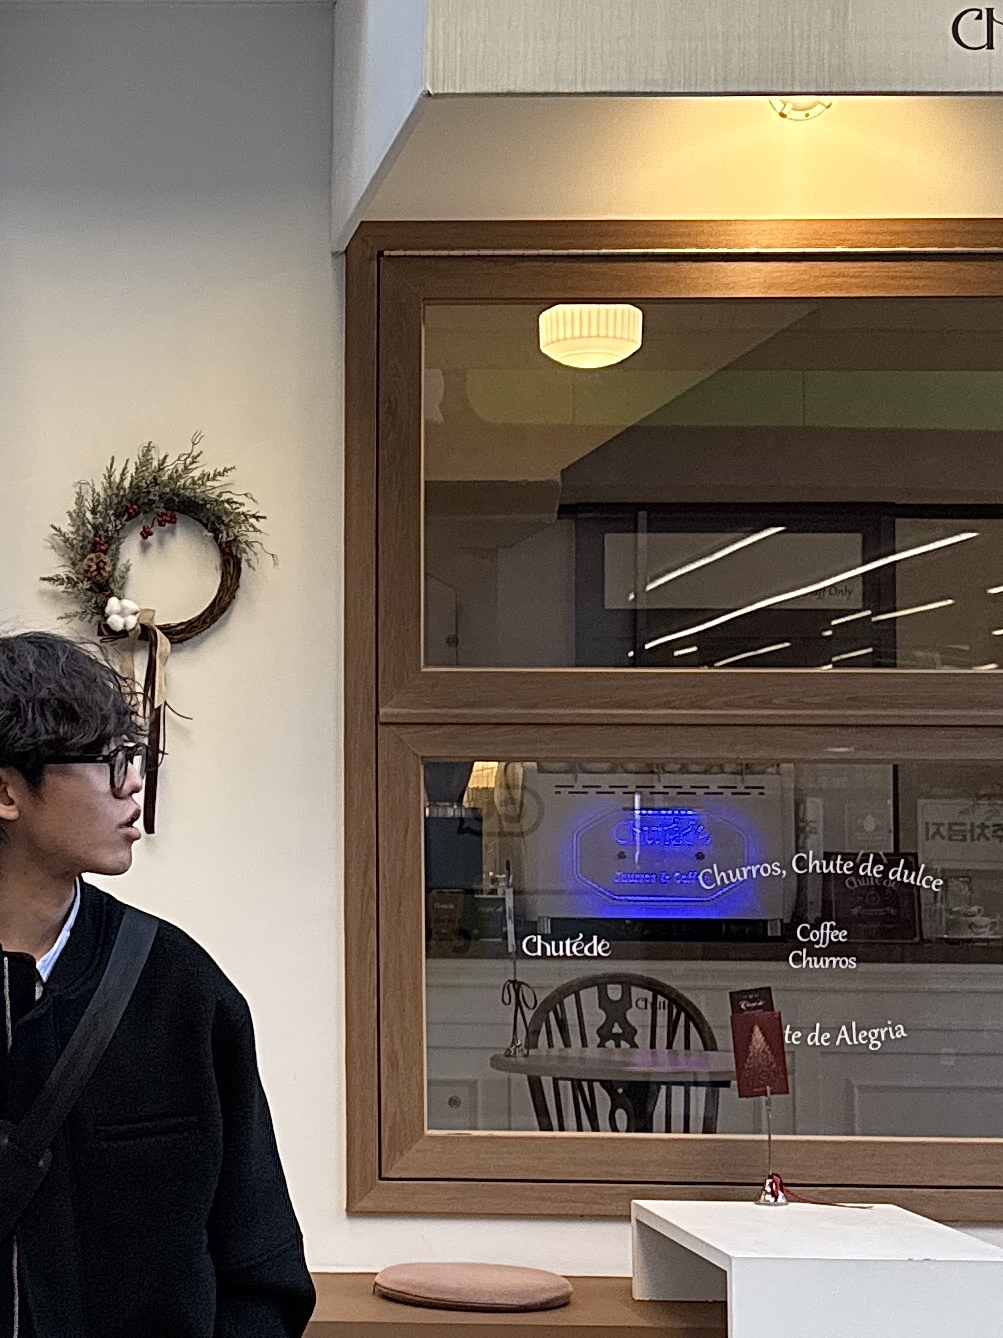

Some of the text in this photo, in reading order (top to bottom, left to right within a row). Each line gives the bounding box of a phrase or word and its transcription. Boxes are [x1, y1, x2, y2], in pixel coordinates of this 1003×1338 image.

[697, 849, 944, 892] Churros, Chute de dulce
[522, 932, 612, 957] Chutéde
[796, 921, 848, 949] Coffee
[788, 950, 857, 969] Churros
[806, 1022, 831, 1047] de
[834, 1019, 909, 1051] Alegria
